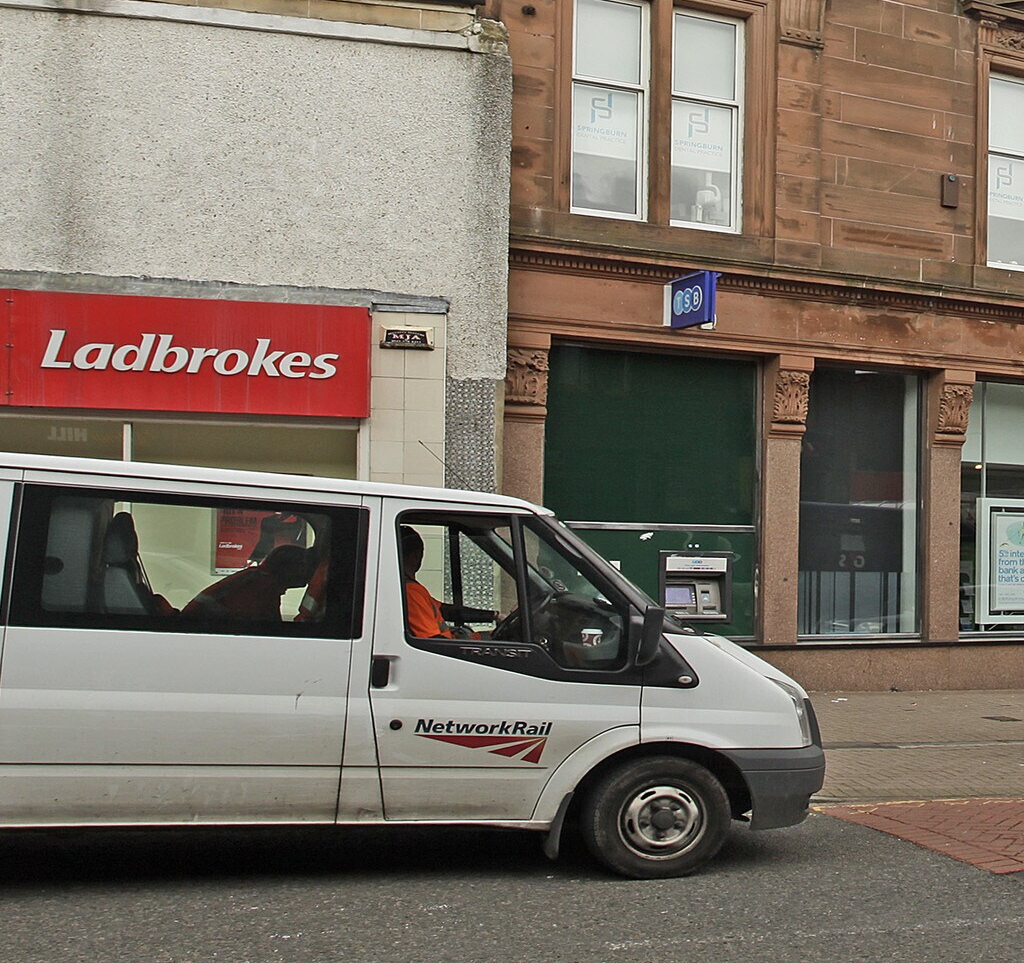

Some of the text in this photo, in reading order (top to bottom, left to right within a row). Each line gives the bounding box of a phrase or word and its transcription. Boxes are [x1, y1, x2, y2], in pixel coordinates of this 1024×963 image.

[577, 125, 627, 138] SPRINGBURN
[674, 139, 723, 151] SPRINGBURN
[674, 289, 700, 311] TSB
[40, 329, 340, 380] Ladbrokes
[998, 566, 1018, 574] bank
[460, 646, 532, 658] TRANSIT
[414, 718, 553, 736] NetworkRail
